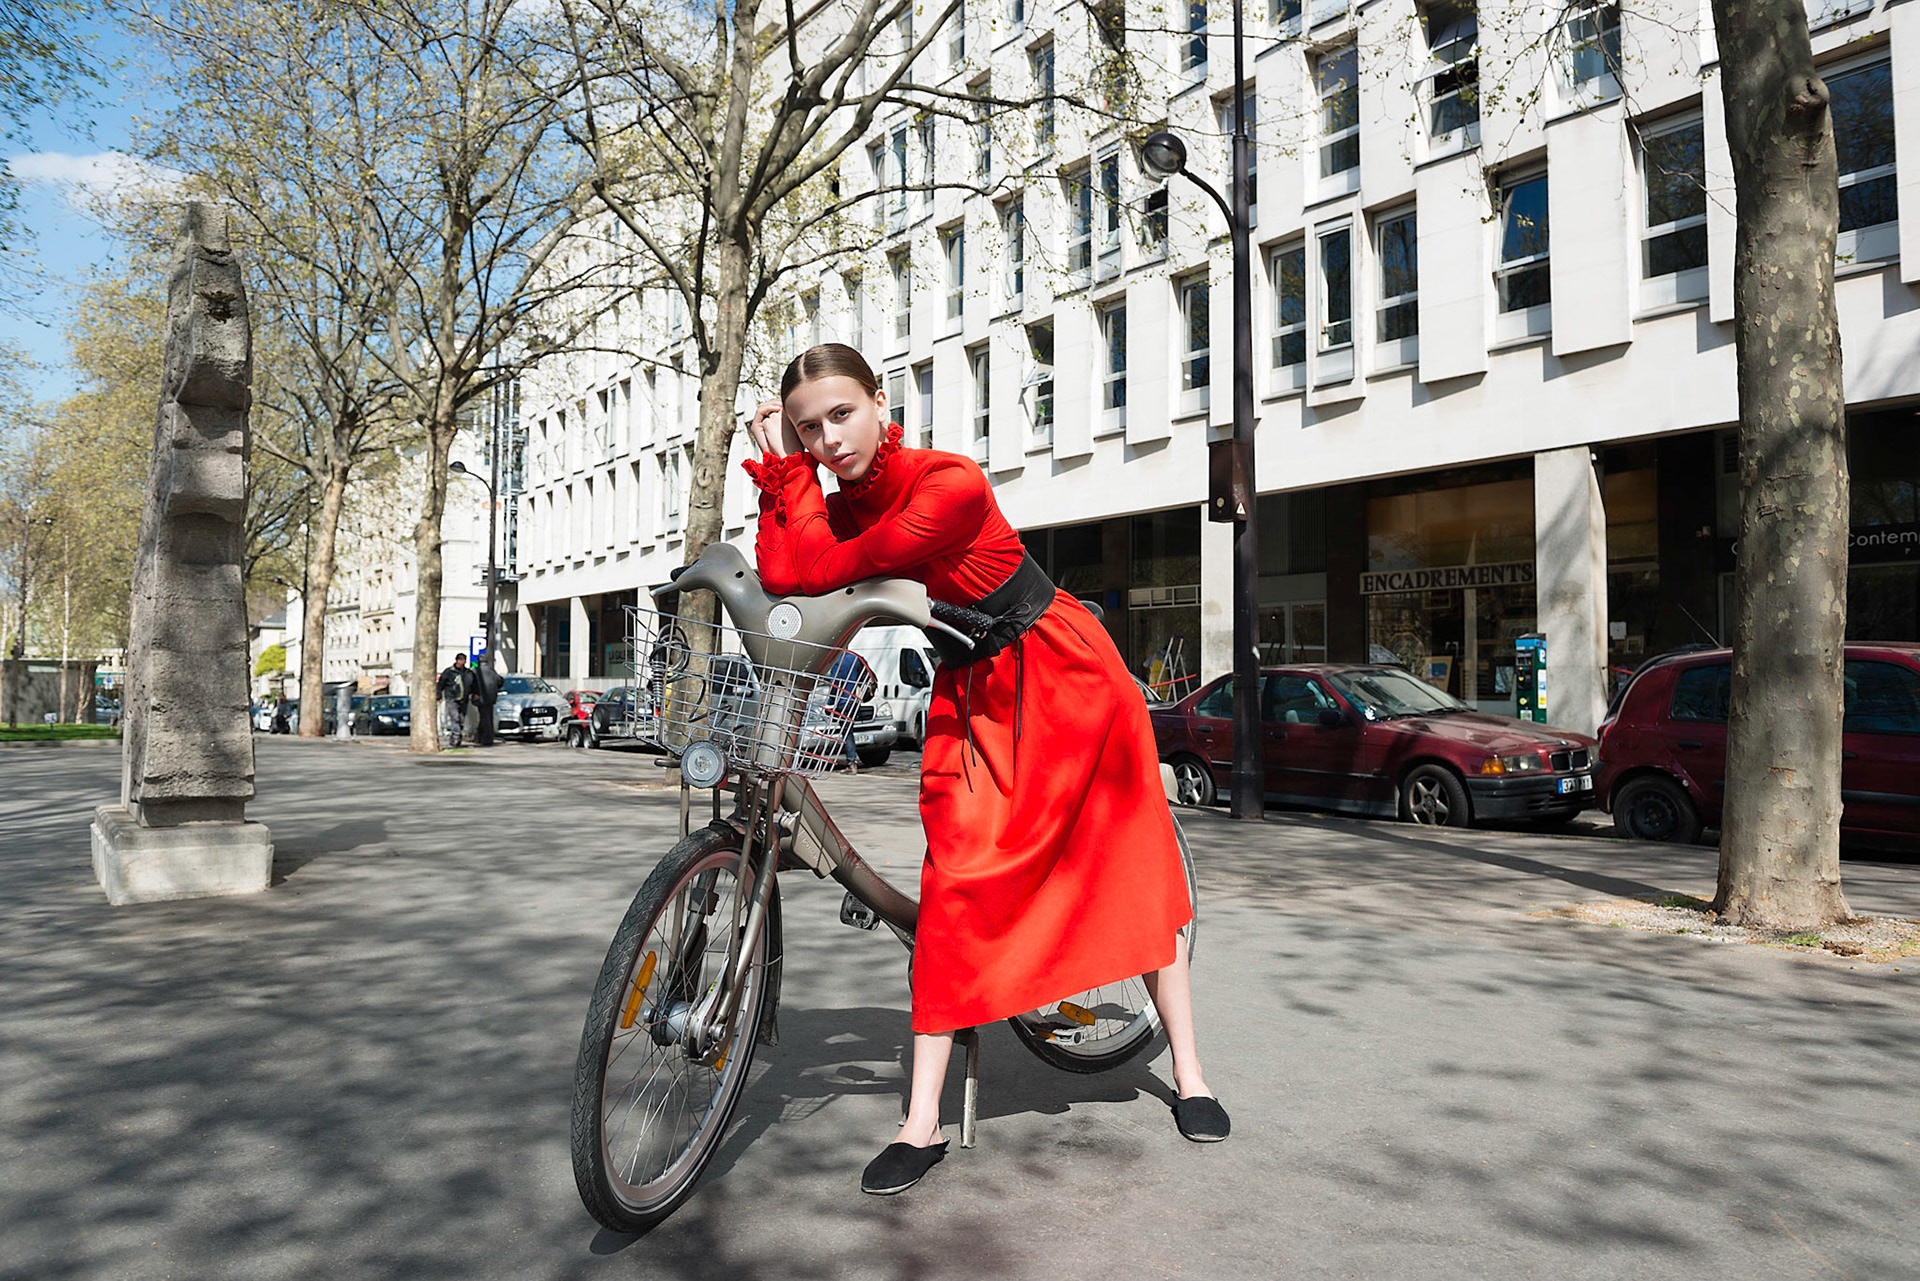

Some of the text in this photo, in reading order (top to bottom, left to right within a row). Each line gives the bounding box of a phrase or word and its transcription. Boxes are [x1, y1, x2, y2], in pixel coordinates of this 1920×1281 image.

[1848, 531, 1920, 548] Contem
[1363, 563, 1533, 592] ENCADREMENTS
[472, 638, 487, 656] P
